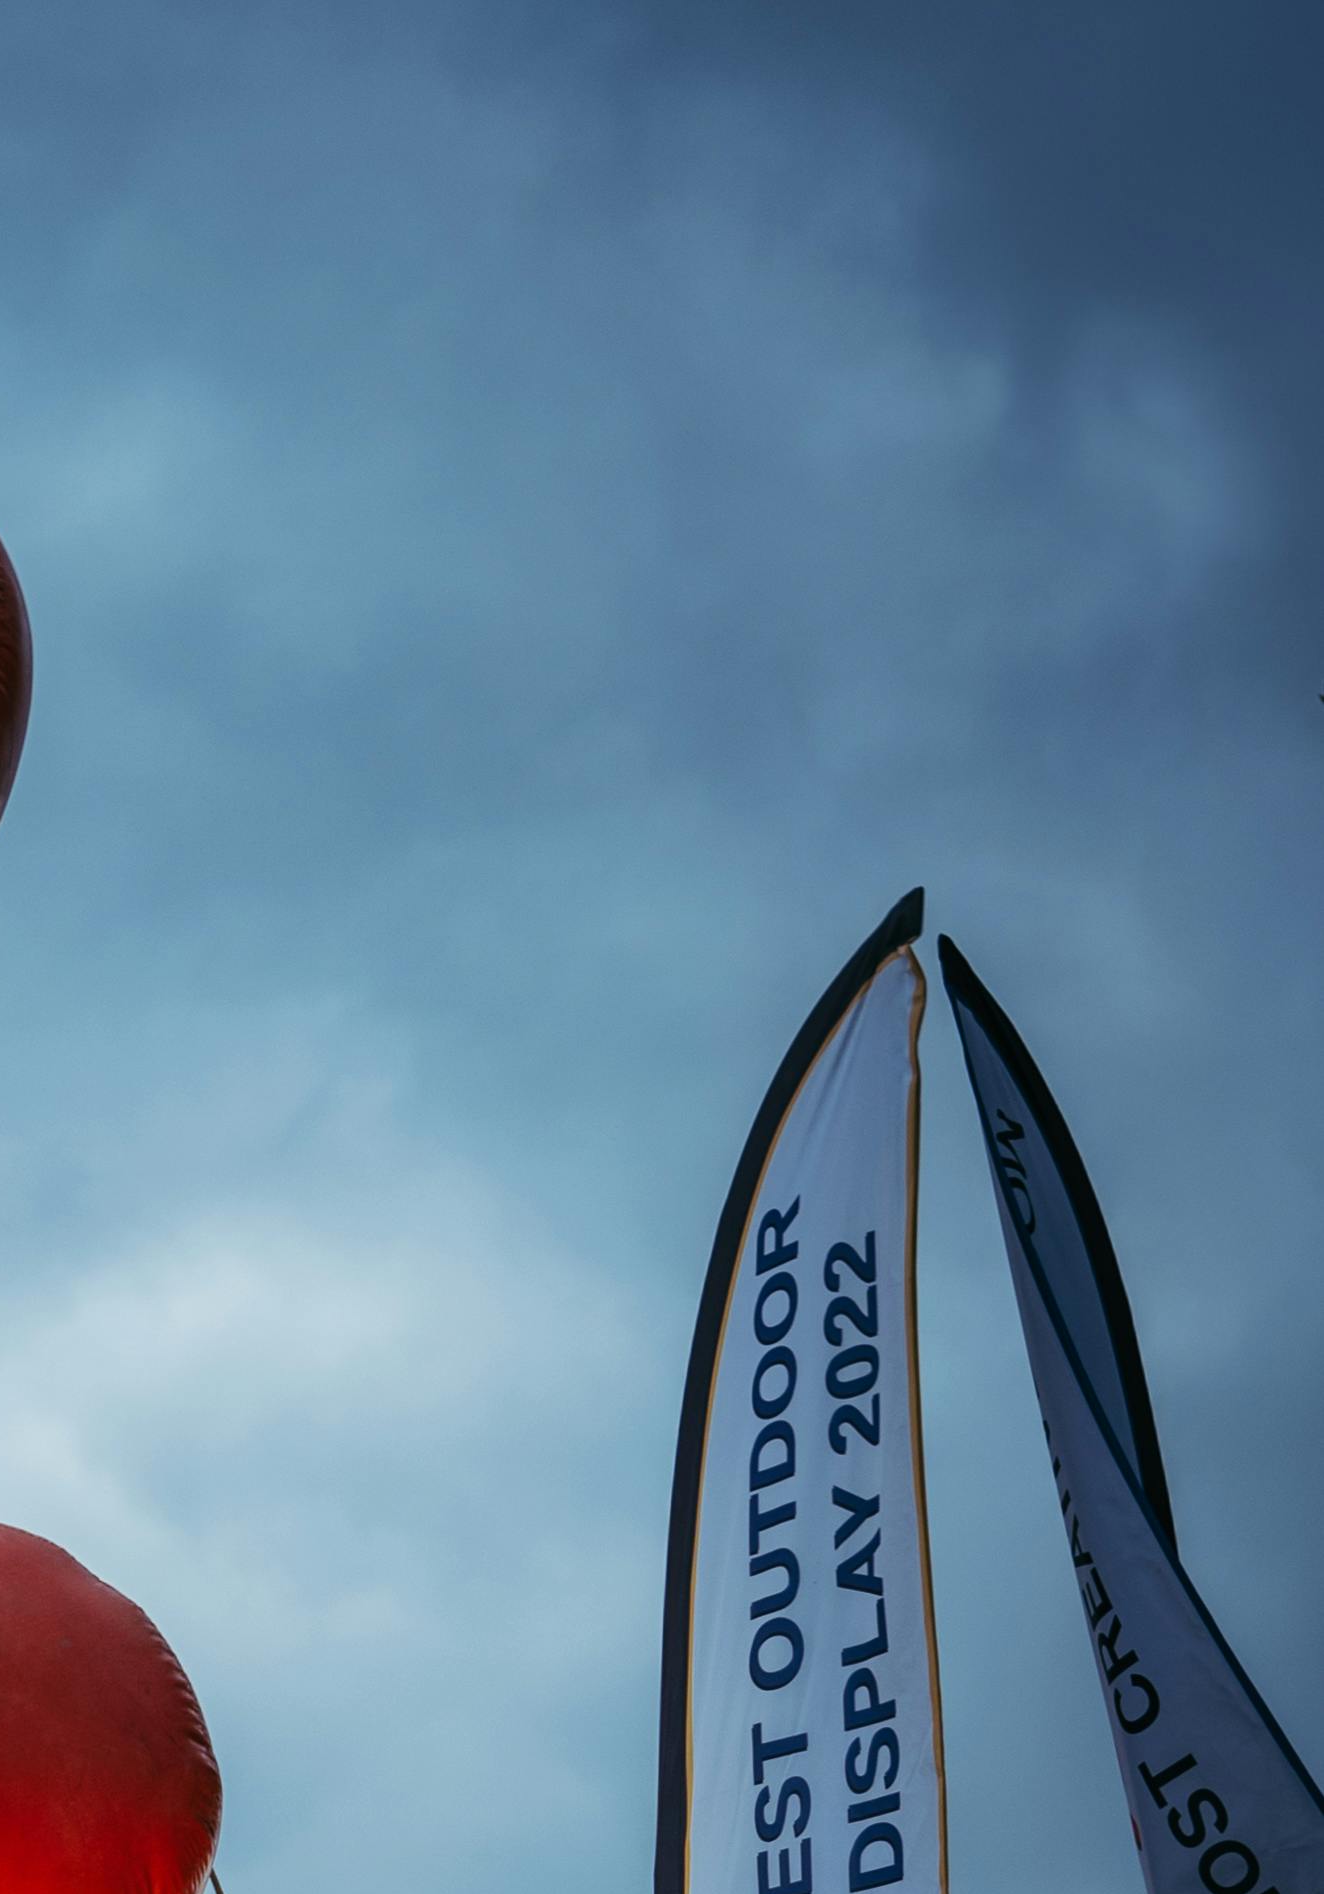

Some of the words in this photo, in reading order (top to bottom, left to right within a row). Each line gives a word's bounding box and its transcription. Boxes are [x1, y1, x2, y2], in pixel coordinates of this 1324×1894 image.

[748, 1193, 805, 1692] OUTDOOR
[823, 1230, 880, 1455] 2022
[832, 1485, 904, 1893] DISPLAY
